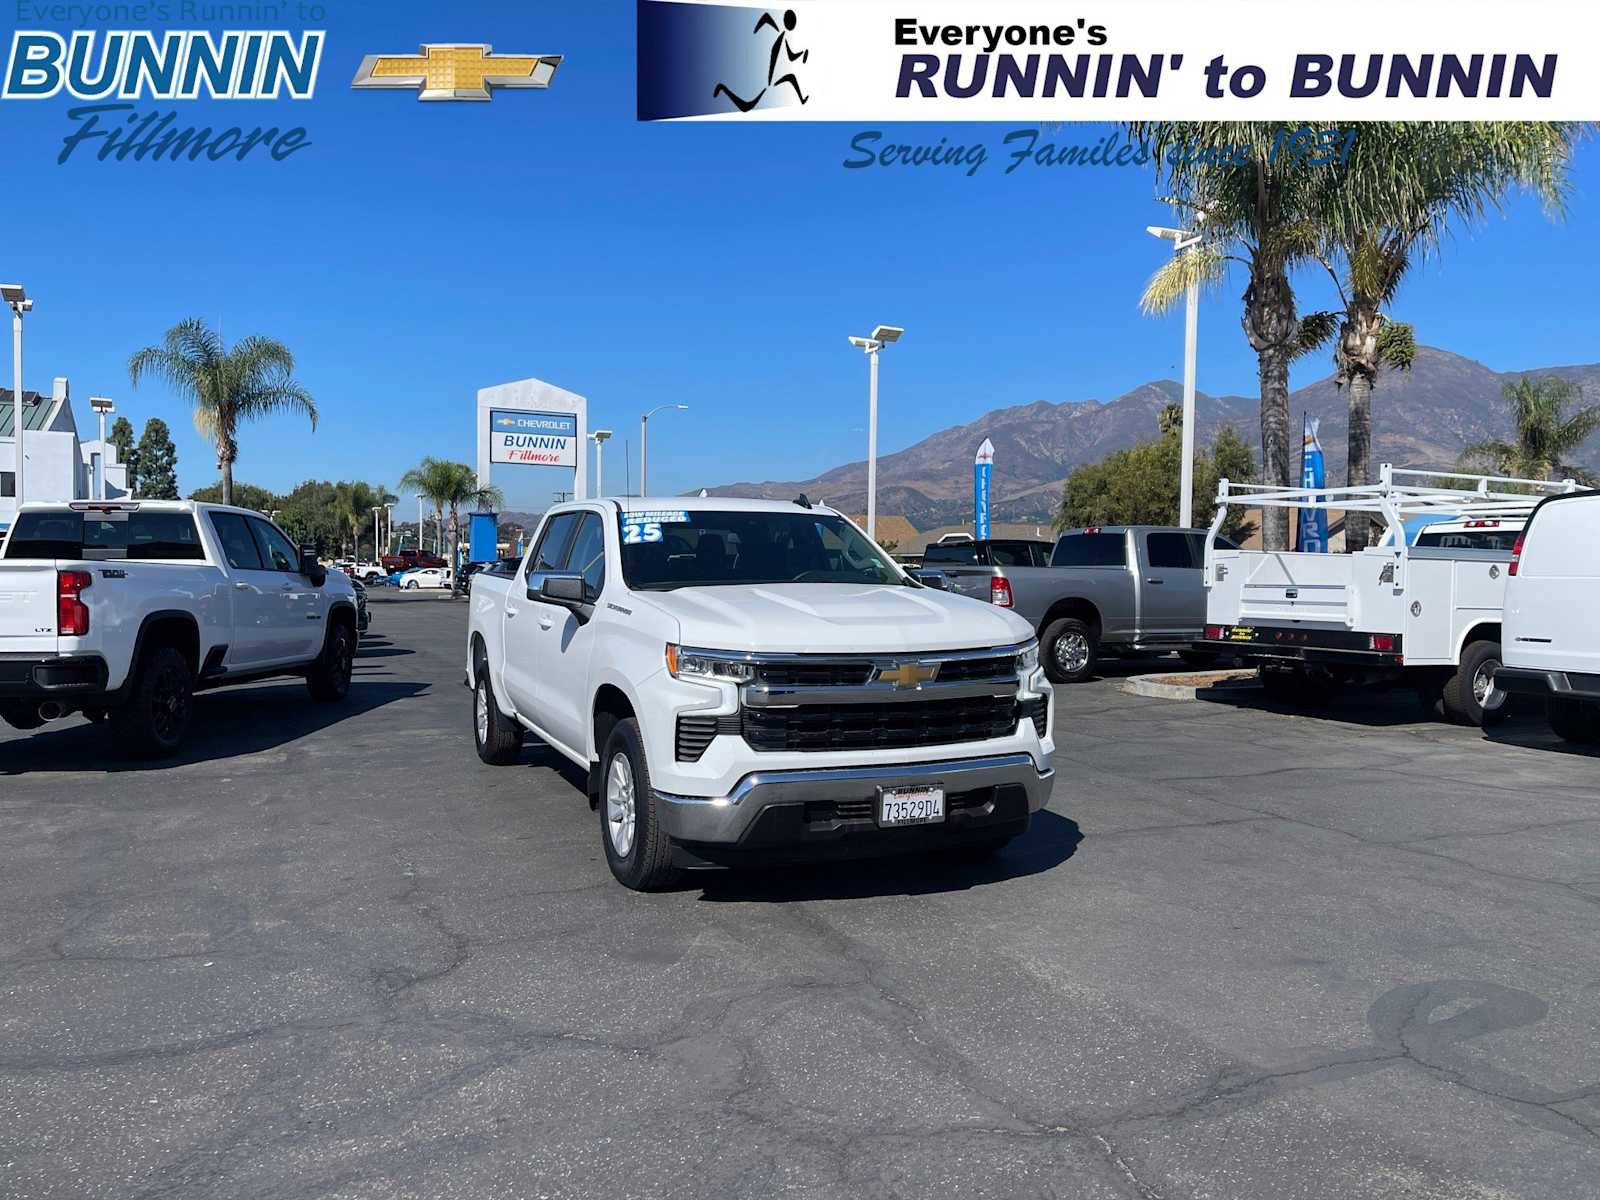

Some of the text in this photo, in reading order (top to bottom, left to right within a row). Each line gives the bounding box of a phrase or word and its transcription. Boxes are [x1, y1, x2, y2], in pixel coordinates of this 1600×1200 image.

[518, 419, 571, 430] CHEVROLET
[504, 435, 566, 450] BUNNIN
[508, 450, 560, 462] Fillmore
[623, 523, 663, 545] 25
[885, 800, 939, 819] 73529D4
